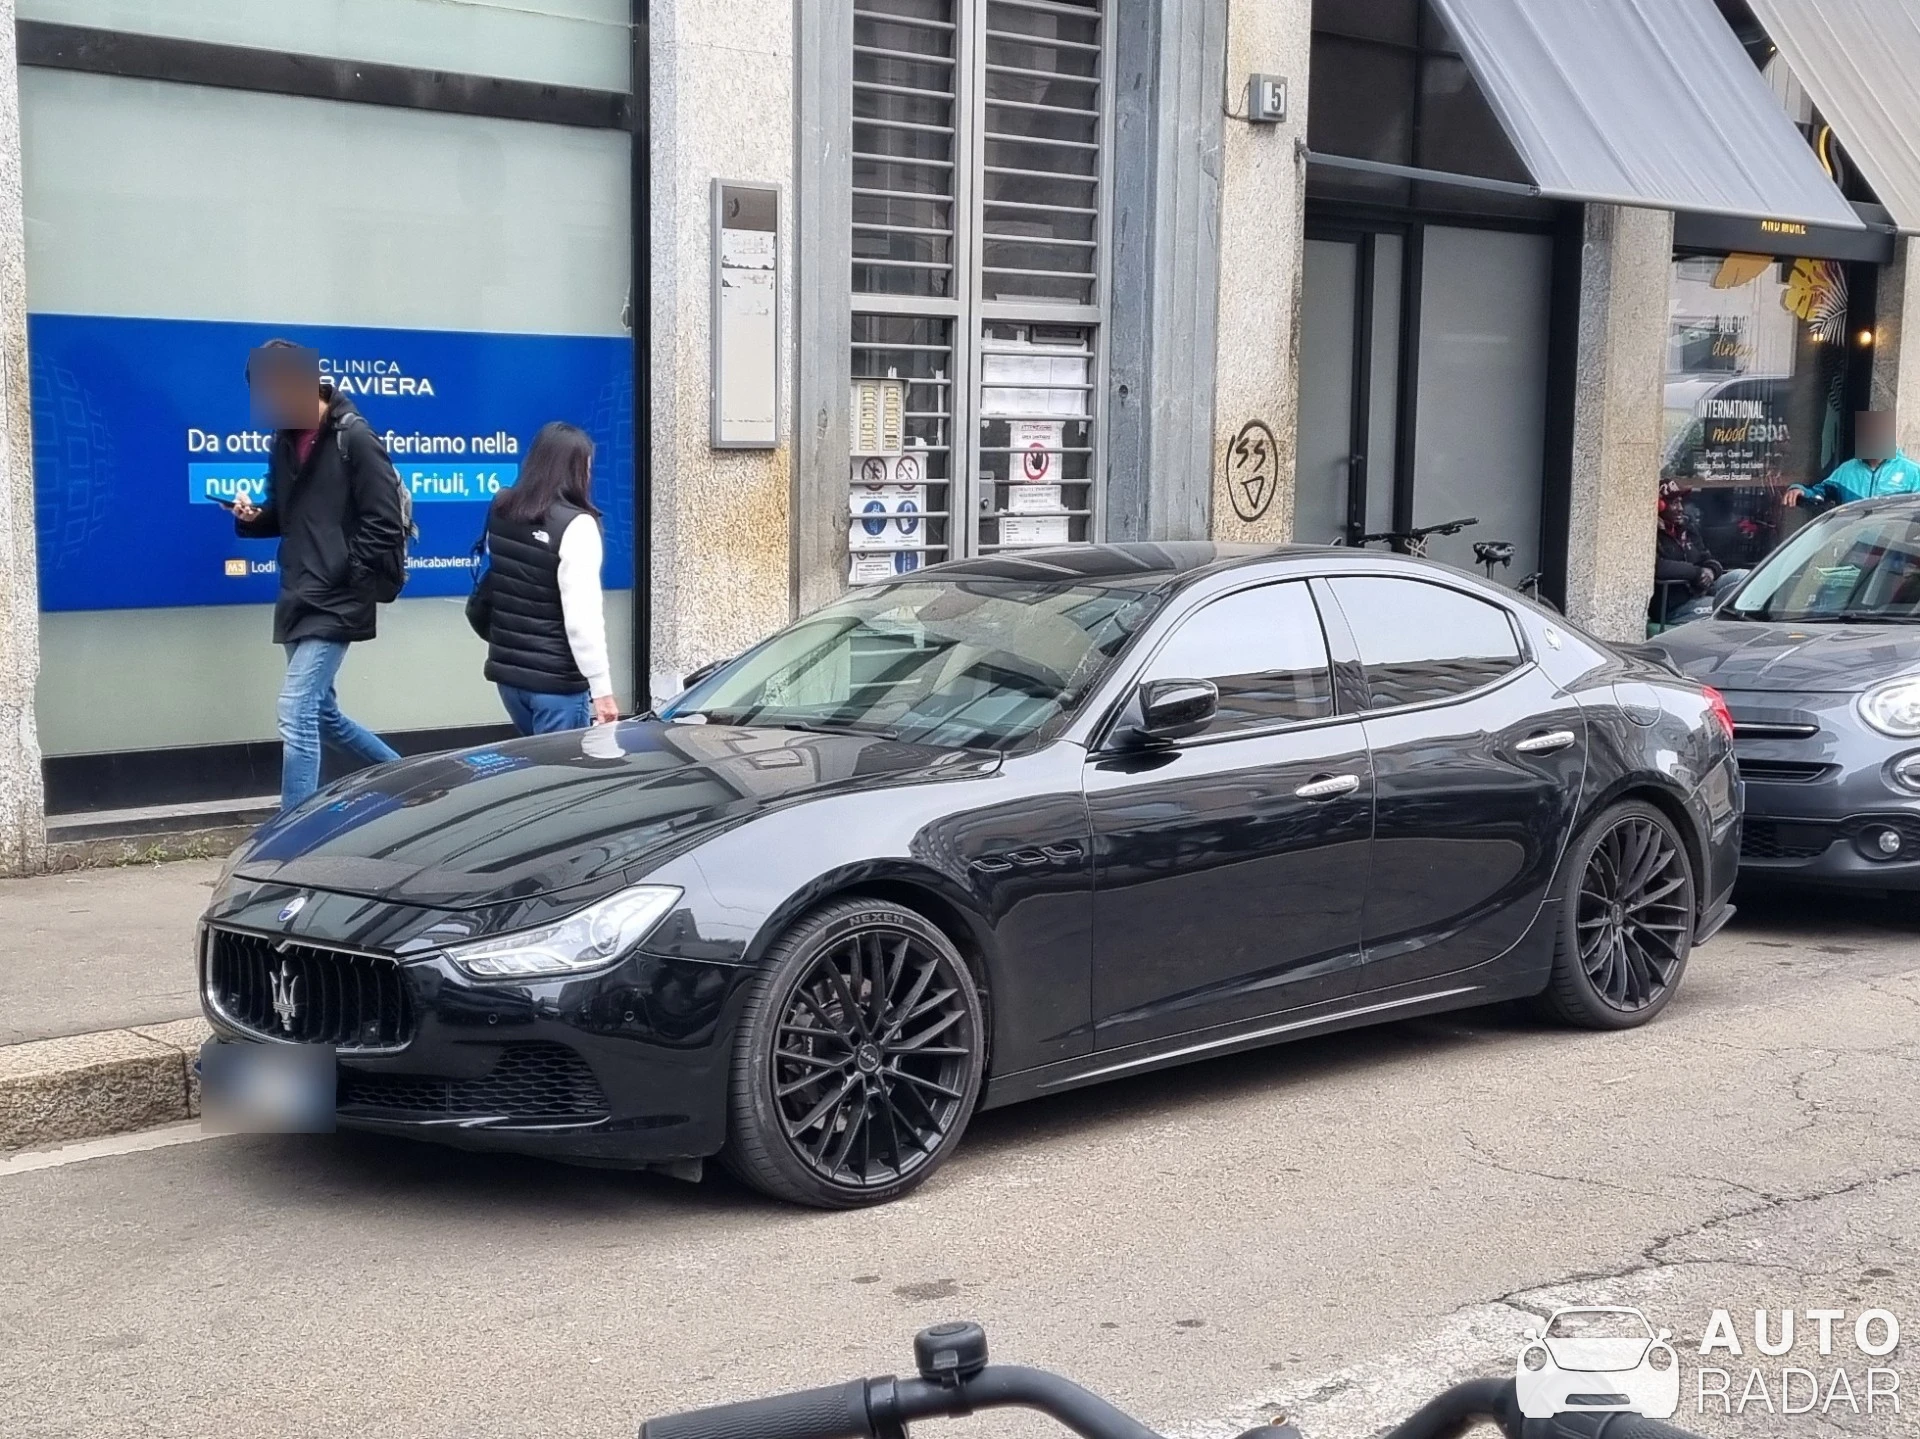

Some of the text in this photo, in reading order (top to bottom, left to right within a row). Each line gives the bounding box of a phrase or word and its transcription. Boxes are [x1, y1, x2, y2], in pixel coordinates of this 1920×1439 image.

[1271, 83, 1282, 112] 5
[318, 358, 401, 375] CLINICA
[1698, 400, 1764, 419] INTERNATIONAL
[1712, 415, 1749, 442] mood
[188, 428, 219, 453] Da
[379, 430, 466, 454] feriamo
[471, 431, 518, 454] nella
[411, 472, 469, 496] Friuli,
[476, 472, 500, 494] 16
[251, 560, 276, 573] Lodi
[849, 912, 904, 926] NEXEN
